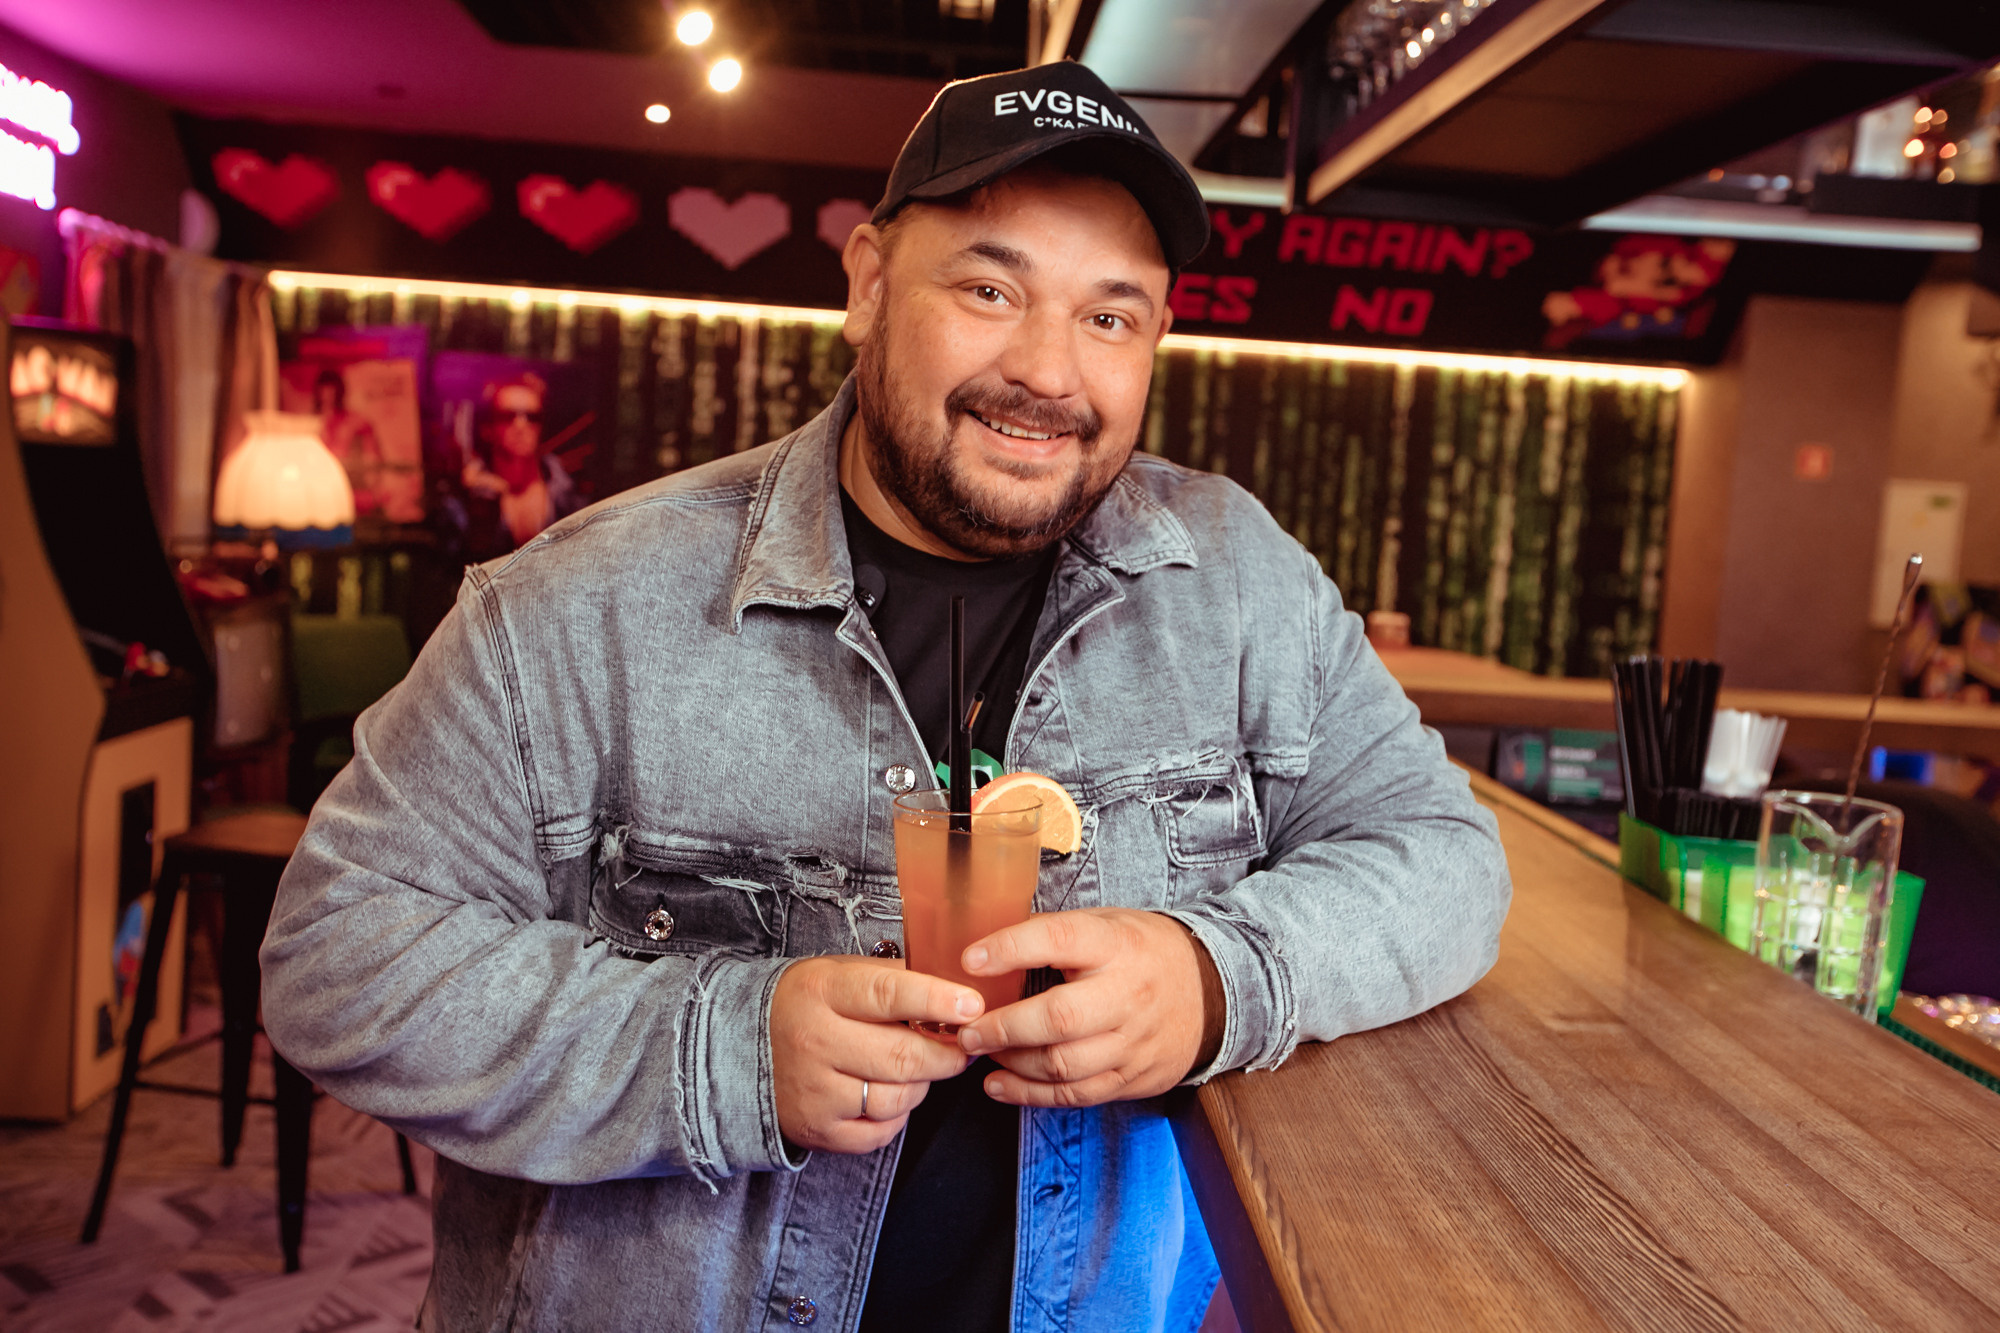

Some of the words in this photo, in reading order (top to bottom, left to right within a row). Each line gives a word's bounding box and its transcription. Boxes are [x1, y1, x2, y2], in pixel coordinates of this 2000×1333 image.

[1277, 214, 1535, 279] AGAIN?
[1169, 272, 1258, 324] ES
[1329, 284, 1435, 337] NO
